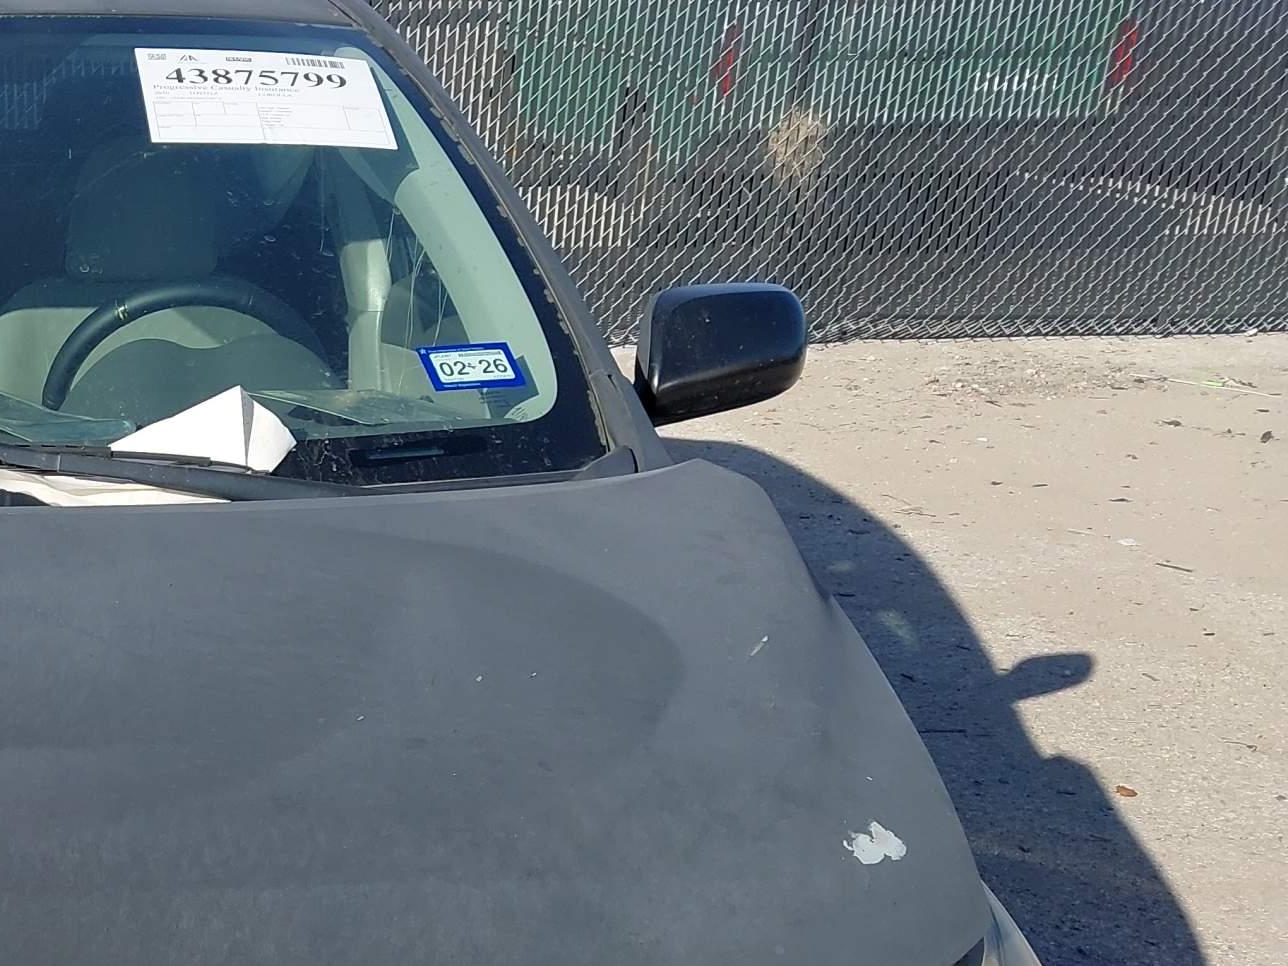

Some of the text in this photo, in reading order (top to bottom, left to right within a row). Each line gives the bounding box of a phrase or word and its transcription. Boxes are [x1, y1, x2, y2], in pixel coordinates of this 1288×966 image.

[165, 67, 347, 89] 43875799
[439, 358, 508, 377] 02 26
